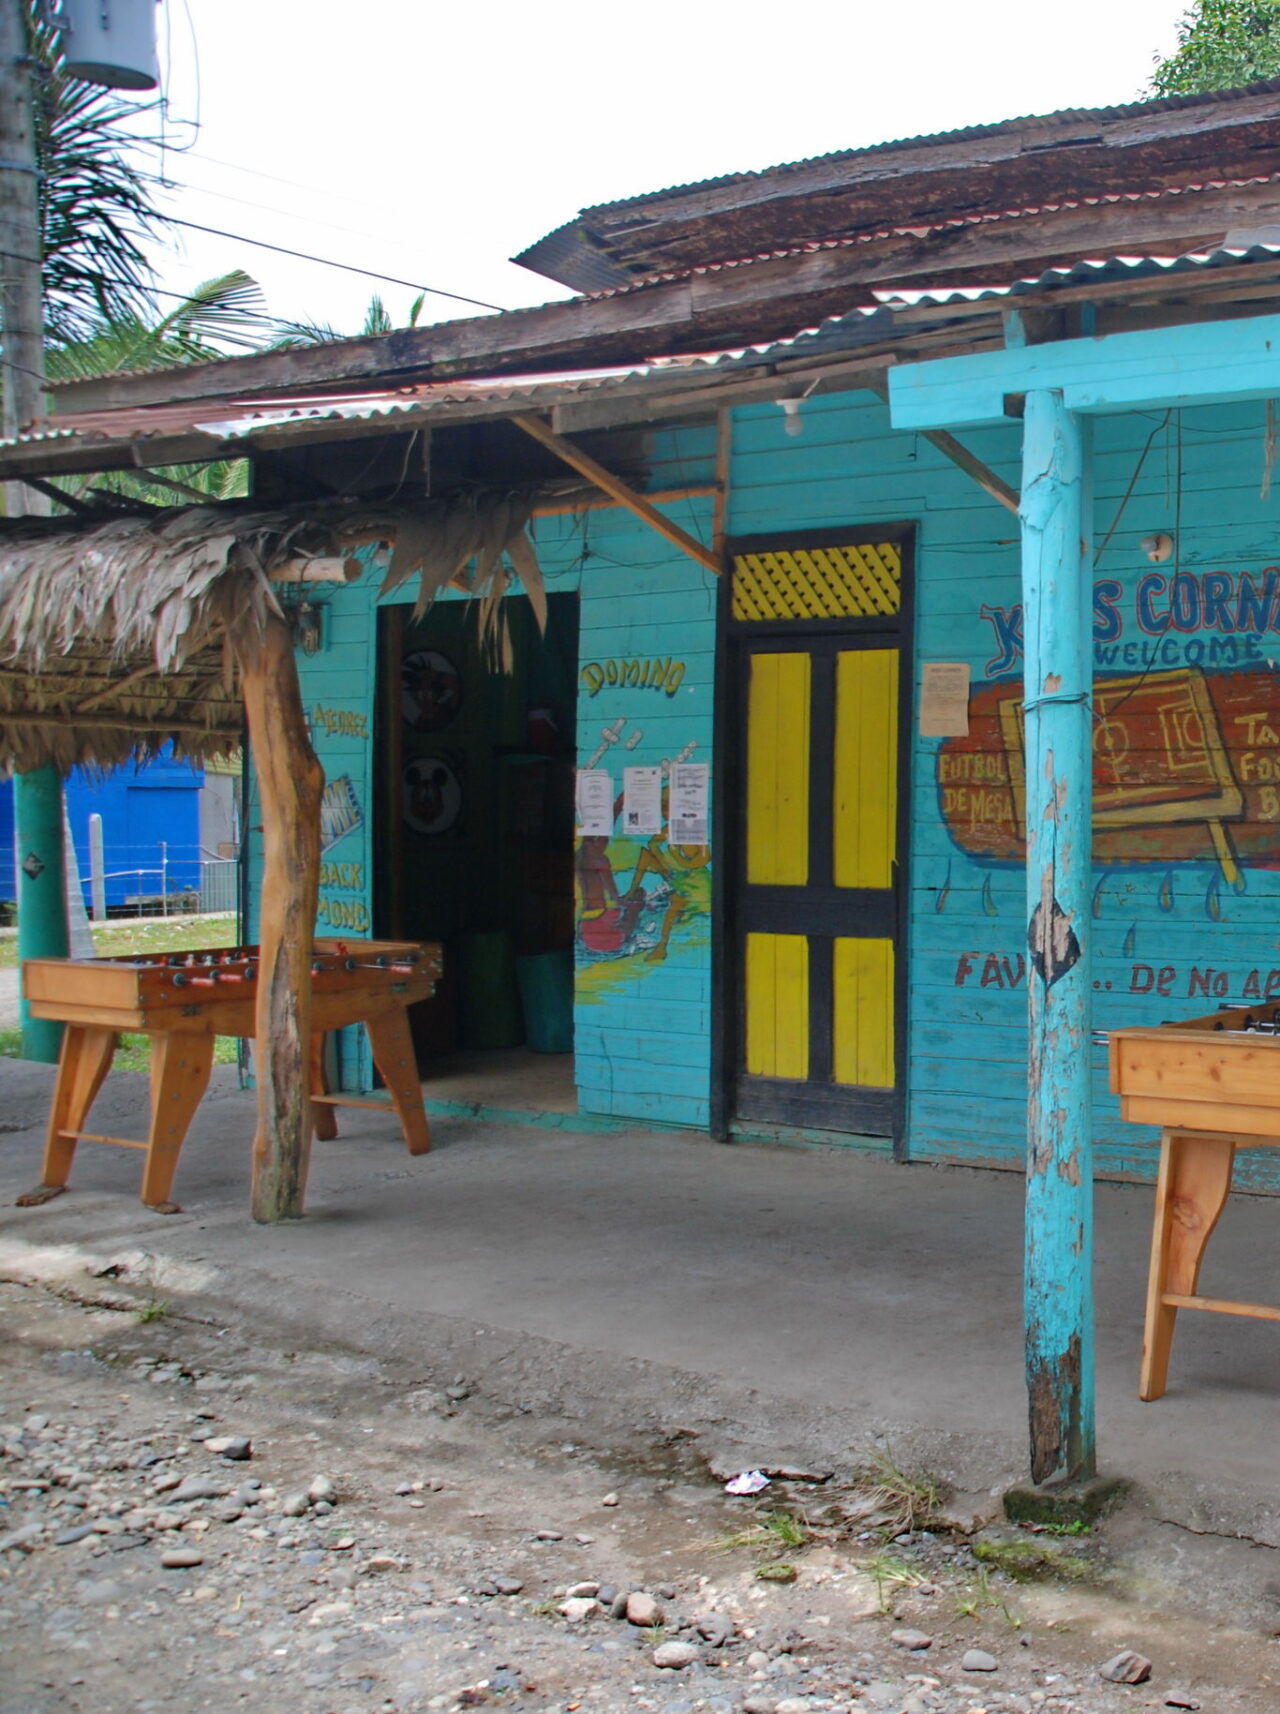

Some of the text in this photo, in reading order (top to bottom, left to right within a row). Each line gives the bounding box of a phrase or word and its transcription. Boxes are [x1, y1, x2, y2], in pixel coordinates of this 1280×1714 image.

[978, 578, 1123, 678] KS
[1093, 633, 1264, 666] WELCOME
[580, 656, 687, 698] DOMINO
[943, 788, 967, 814] DE
